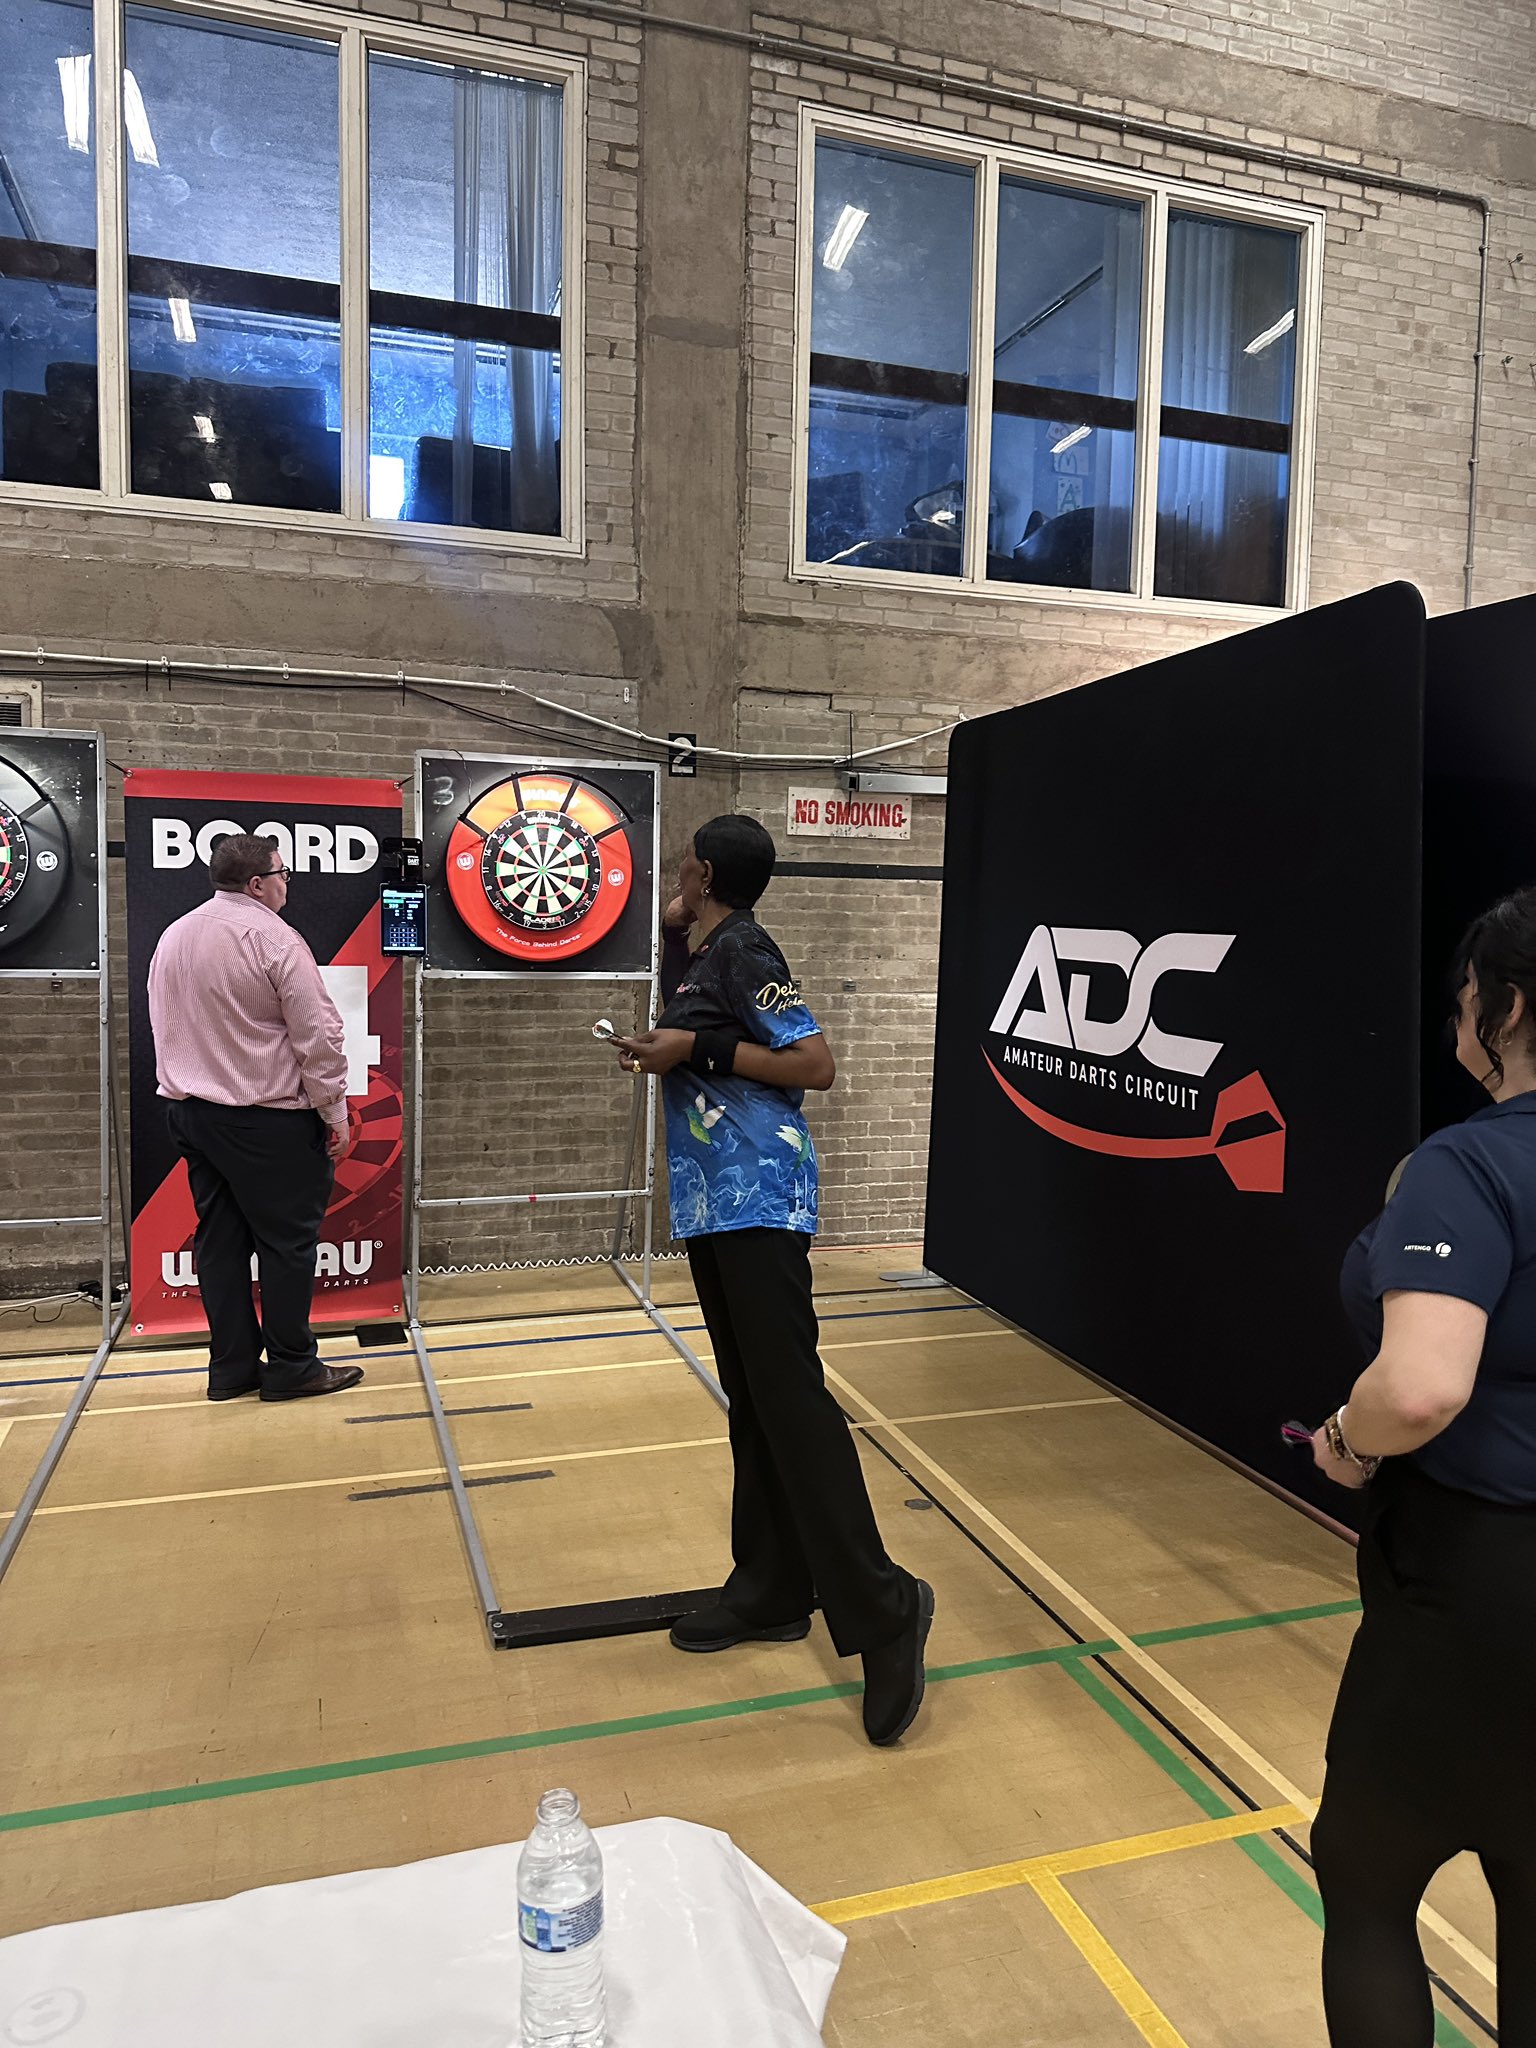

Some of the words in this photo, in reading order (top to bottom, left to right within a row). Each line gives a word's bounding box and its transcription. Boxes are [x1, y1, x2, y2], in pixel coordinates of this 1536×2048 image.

[672, 737, 694, 774] 2
[432, 776, 455, 806] 3
[795, 799, 819, 825] NO
[825, 800, 904, 828] SMOKING
[988, 924, 1237, 1078] ADC
[1003, 1045, 1063, 1077] AMATEUR
[1069, 1061, 1117, 1090] DARTS
[1125, 1074, 1199, 1111] CIRCUIT
[162, 1290, 189, 1299] THE
[323, 1278, 369, 1288] DARTS
